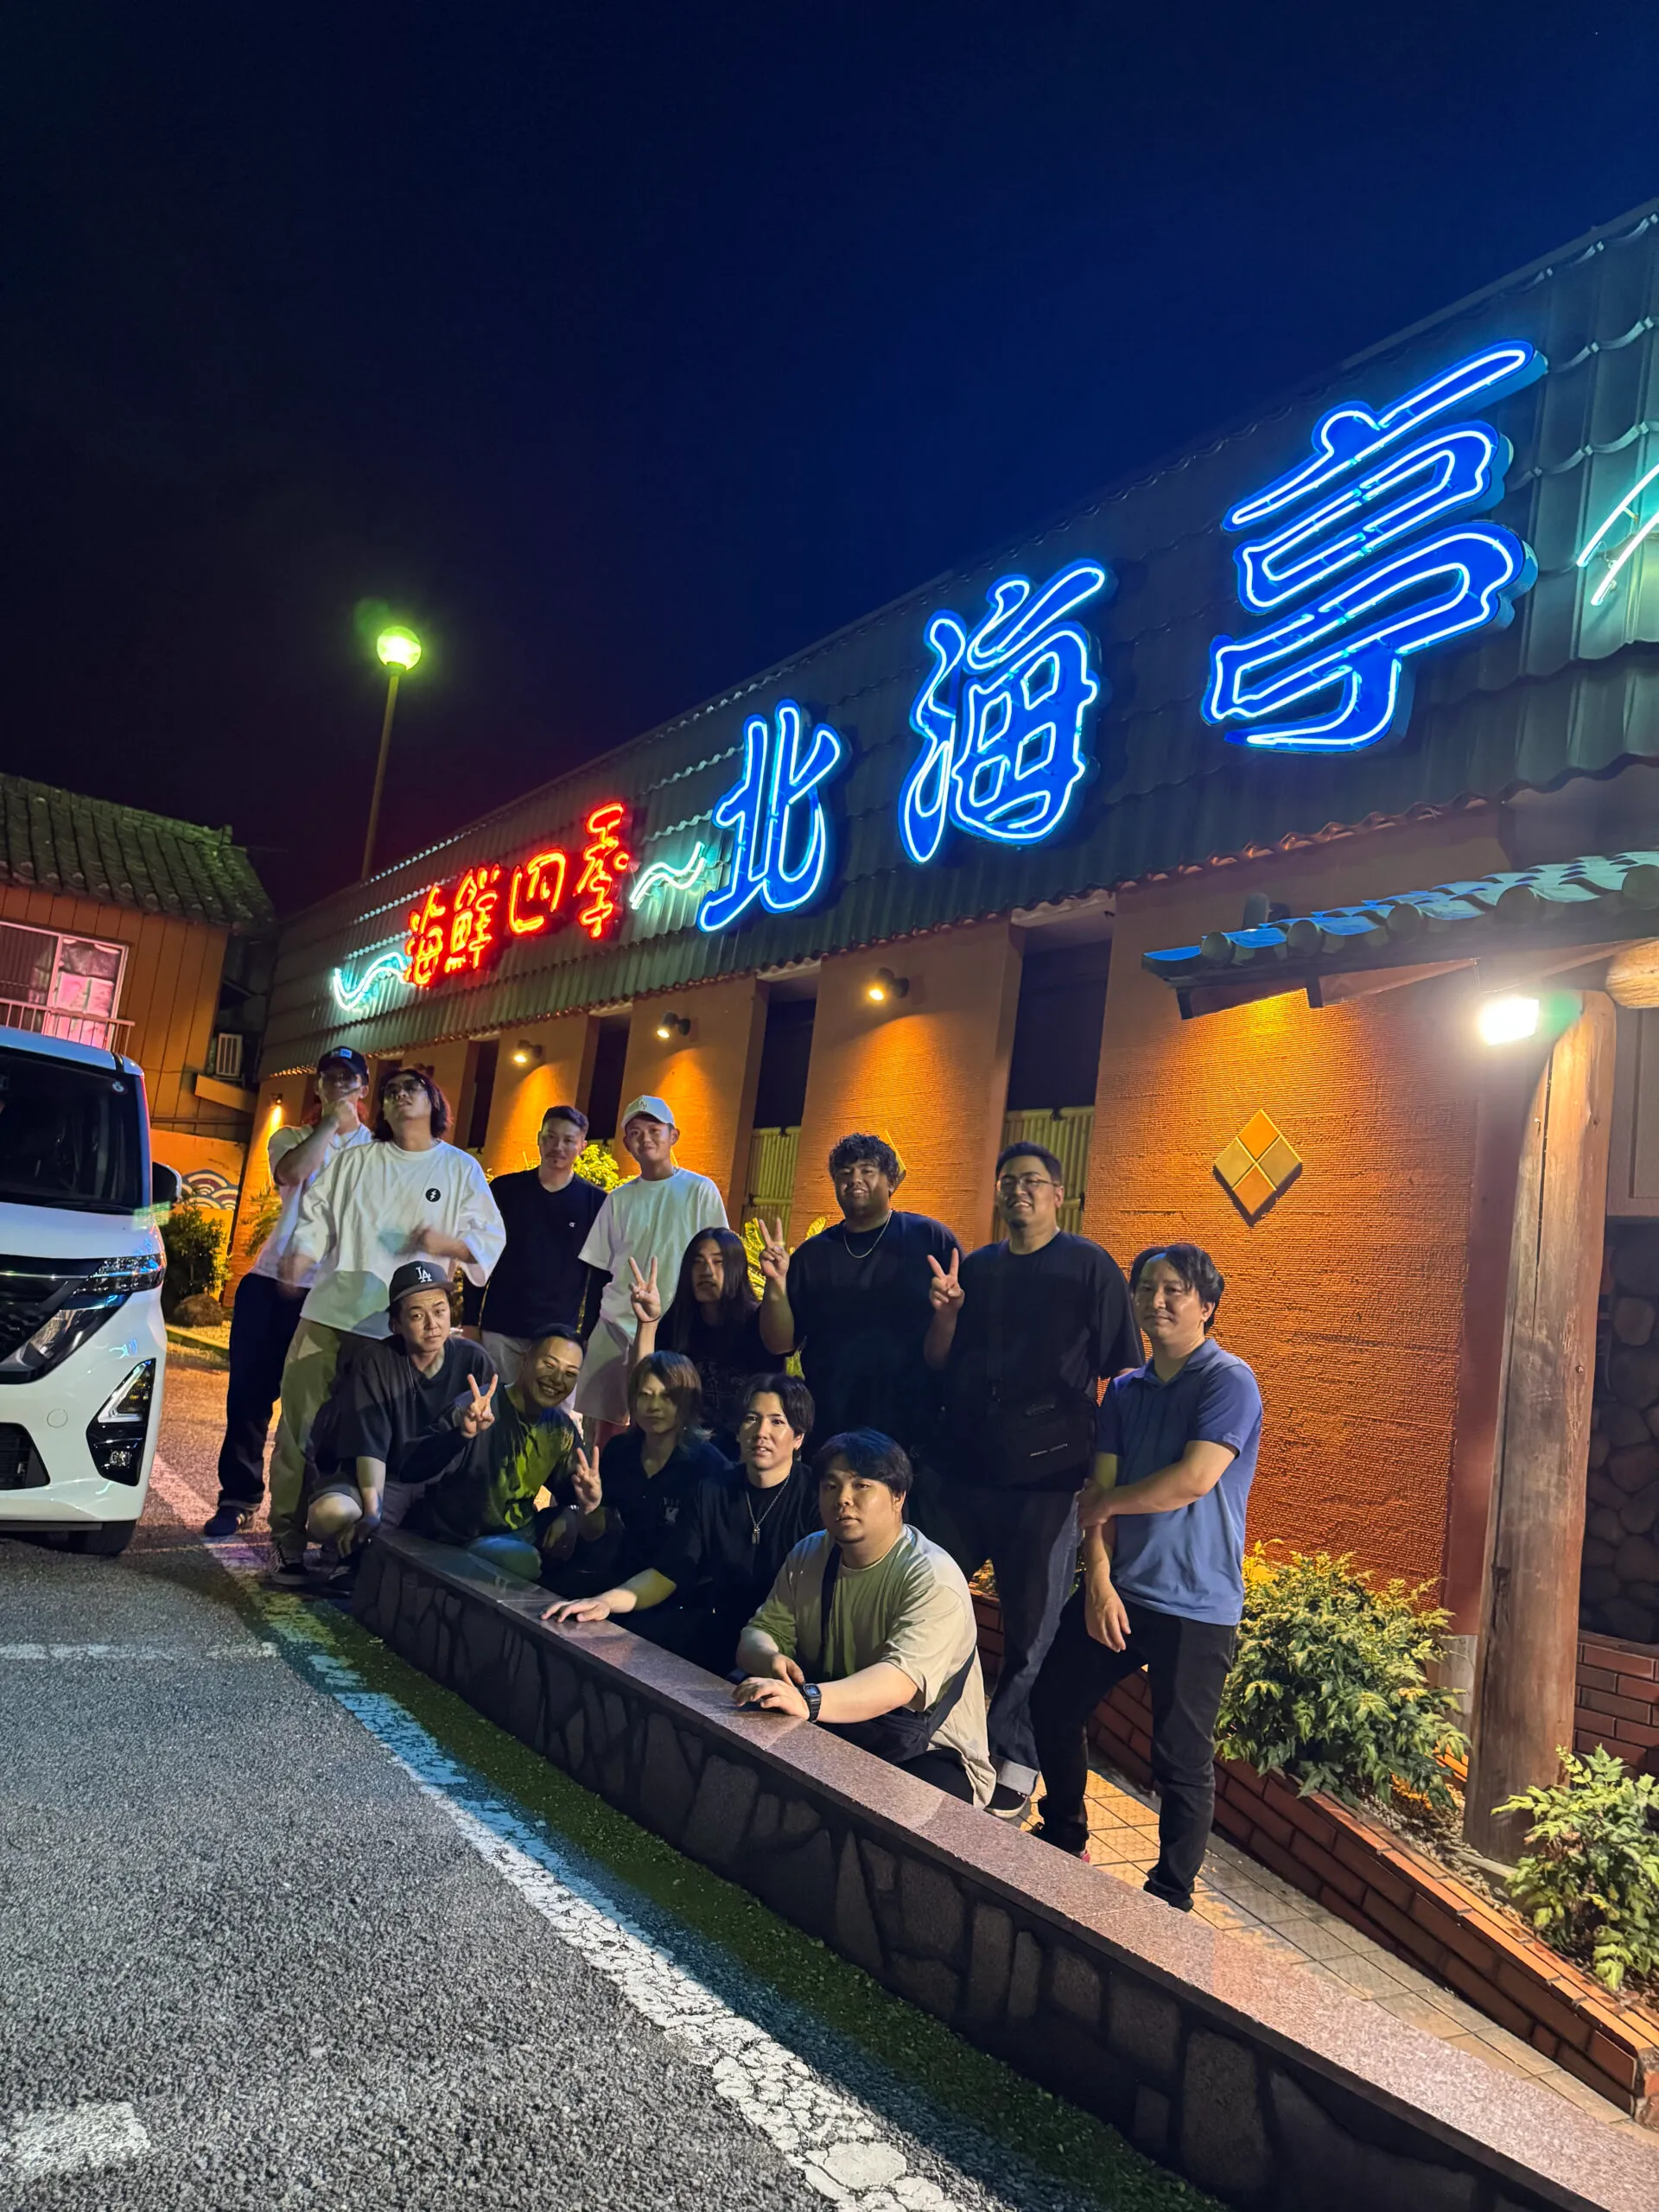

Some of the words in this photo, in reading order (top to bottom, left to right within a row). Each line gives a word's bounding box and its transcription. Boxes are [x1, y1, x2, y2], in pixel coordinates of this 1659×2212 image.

[698, 340, 1541, 932] 北海亭
[404, 803, 630, 986] 海鮮四季
[416, 1266, 433, 1283] LA
